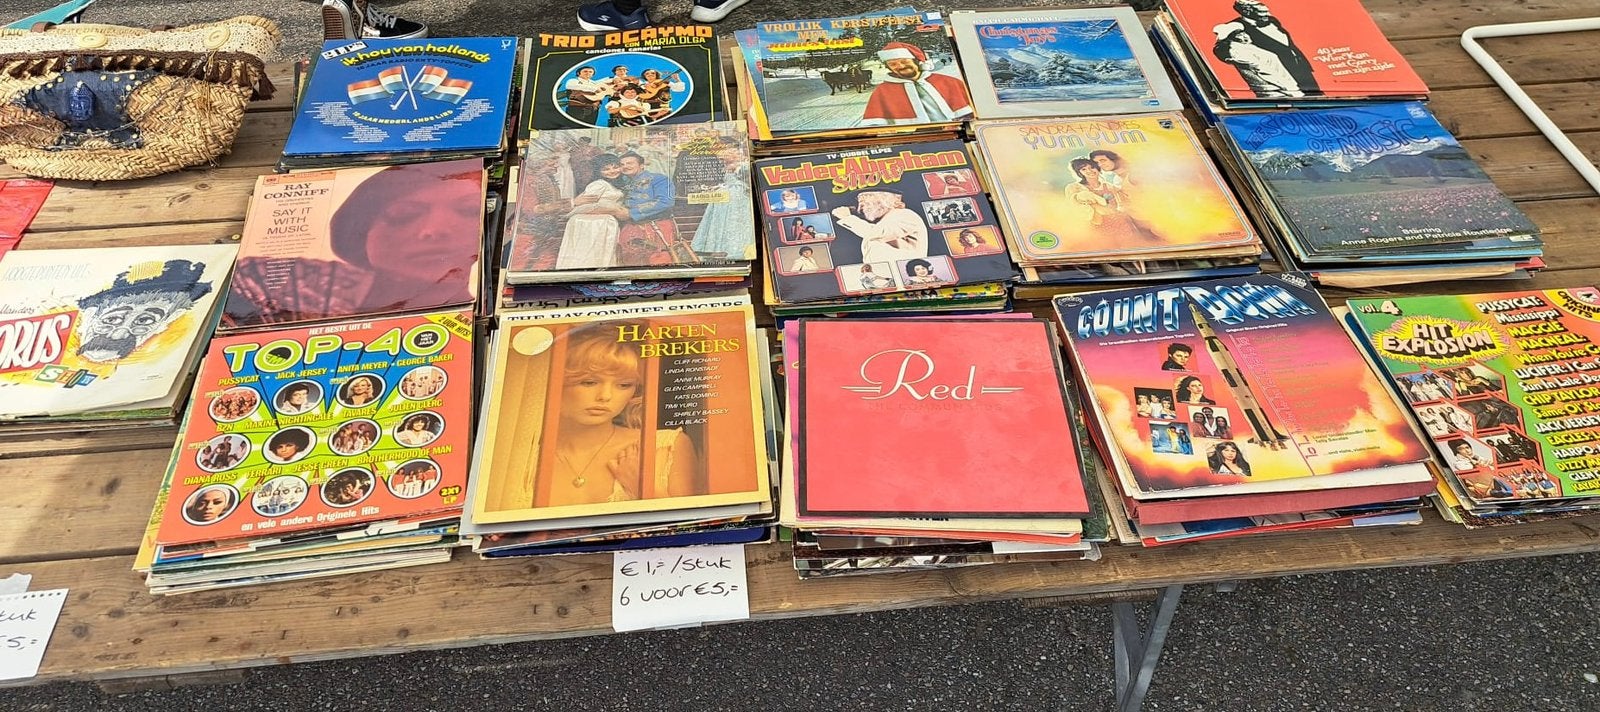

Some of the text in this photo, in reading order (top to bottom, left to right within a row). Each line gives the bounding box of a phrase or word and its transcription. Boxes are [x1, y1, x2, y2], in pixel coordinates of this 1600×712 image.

[539, 26, 713, 48] TRIO ACAYMO
[644, 36, 676, 47] MARIA
[679, 36, 706, 44] OLGA
[341, 57, 358, 66] ik
[357, 48, 391, 60] hou
[393, 45, 424, 53] van
[1018, 124, 1074, 136] SANDRA
[1089, 120, 1141, 132] ANDRES
[1259, 112, 1357, 138] SOUND
[1023, 129, 1147, 150] YUM YUM
[1307, 137, 1337, 153] OF
[763, 150, 968, 186] Vader Abraham
[264, 188, 329, 200] CONNIFF
[284, 183, 312, 191] RAY
[272, 208, 296, 217] SAY
[274, 216, 306, 226] WITH
[266, 225, 309, 235] MUSIC
[1368, 236, 1403, 245] Rogers
[1424, 231, 1462, 240] Patricia
[1463, 227, 1513, 238] Routledge
[1401, 227, 1441, 235] Starring
[1077, 281, 1317, 339] COUNT DOWN
[1358, 299, 1401, 315] vol. 4
[1475, 295, 1545, 312] PUSSYCAT:
[1562, 302, 1593, 319] HITS
[1494, 307, 1560, 324] Mississippi
[309, 328, 325, 336] HET
[325, 325, 347, 334] BESTE
[616, 323, 717, 343] HARTEN
[1411, 322, 1450, 340] HIT
[1506, 320, 1565, 337] MAGGIE
[223, 323, 450, 373] TOP-40
[640, 338, 740, 358] BREKERS
[1381, 330, 1493, 357] EXPLOSION
[1516, 333, 1587, 350] MACNEAL:
[1514, 353, 1553, 364] When
[1572, 360, 1598, 371] Can
[218, 353, 453, 386] PUSSYCAT JACK JERSEY ANITA MEYER GEORGE BAKER
[860, 349, 977, 400] Red
[1517, 376, 1582, 391] Sun In Late
[1523, 393, 1552, 405] CHIP
[216, 423, 235, 433] BZN
[244, 419, 276, 430] MAXINE
[278, 412, 334, 425] NIGHTINGALE
[343, 407, 377, 418] TAVARES
[702, 408, 729, 416] BASSEY
[1532, 408, 1566, 418] Same
[1534, 420, 1566, 433] JACK
[184, 444, 452, 486] DIANA ROSS FERRARI JESSE GREEN BROTHERHOOD OF MAN
[1555, 459, 1587, 471] DIZZY
[443, 495, 457, 505] LP
[241, 523, 253, 531] en
[280, 515, 313, 526] andere
[316, 509, 357, 523] Originele
[361, 505, 380, 516] Hits
[620, 561, 639, 576] €
[620, 586, 630, 606] 6
[641, 584, 692, 602] voor
